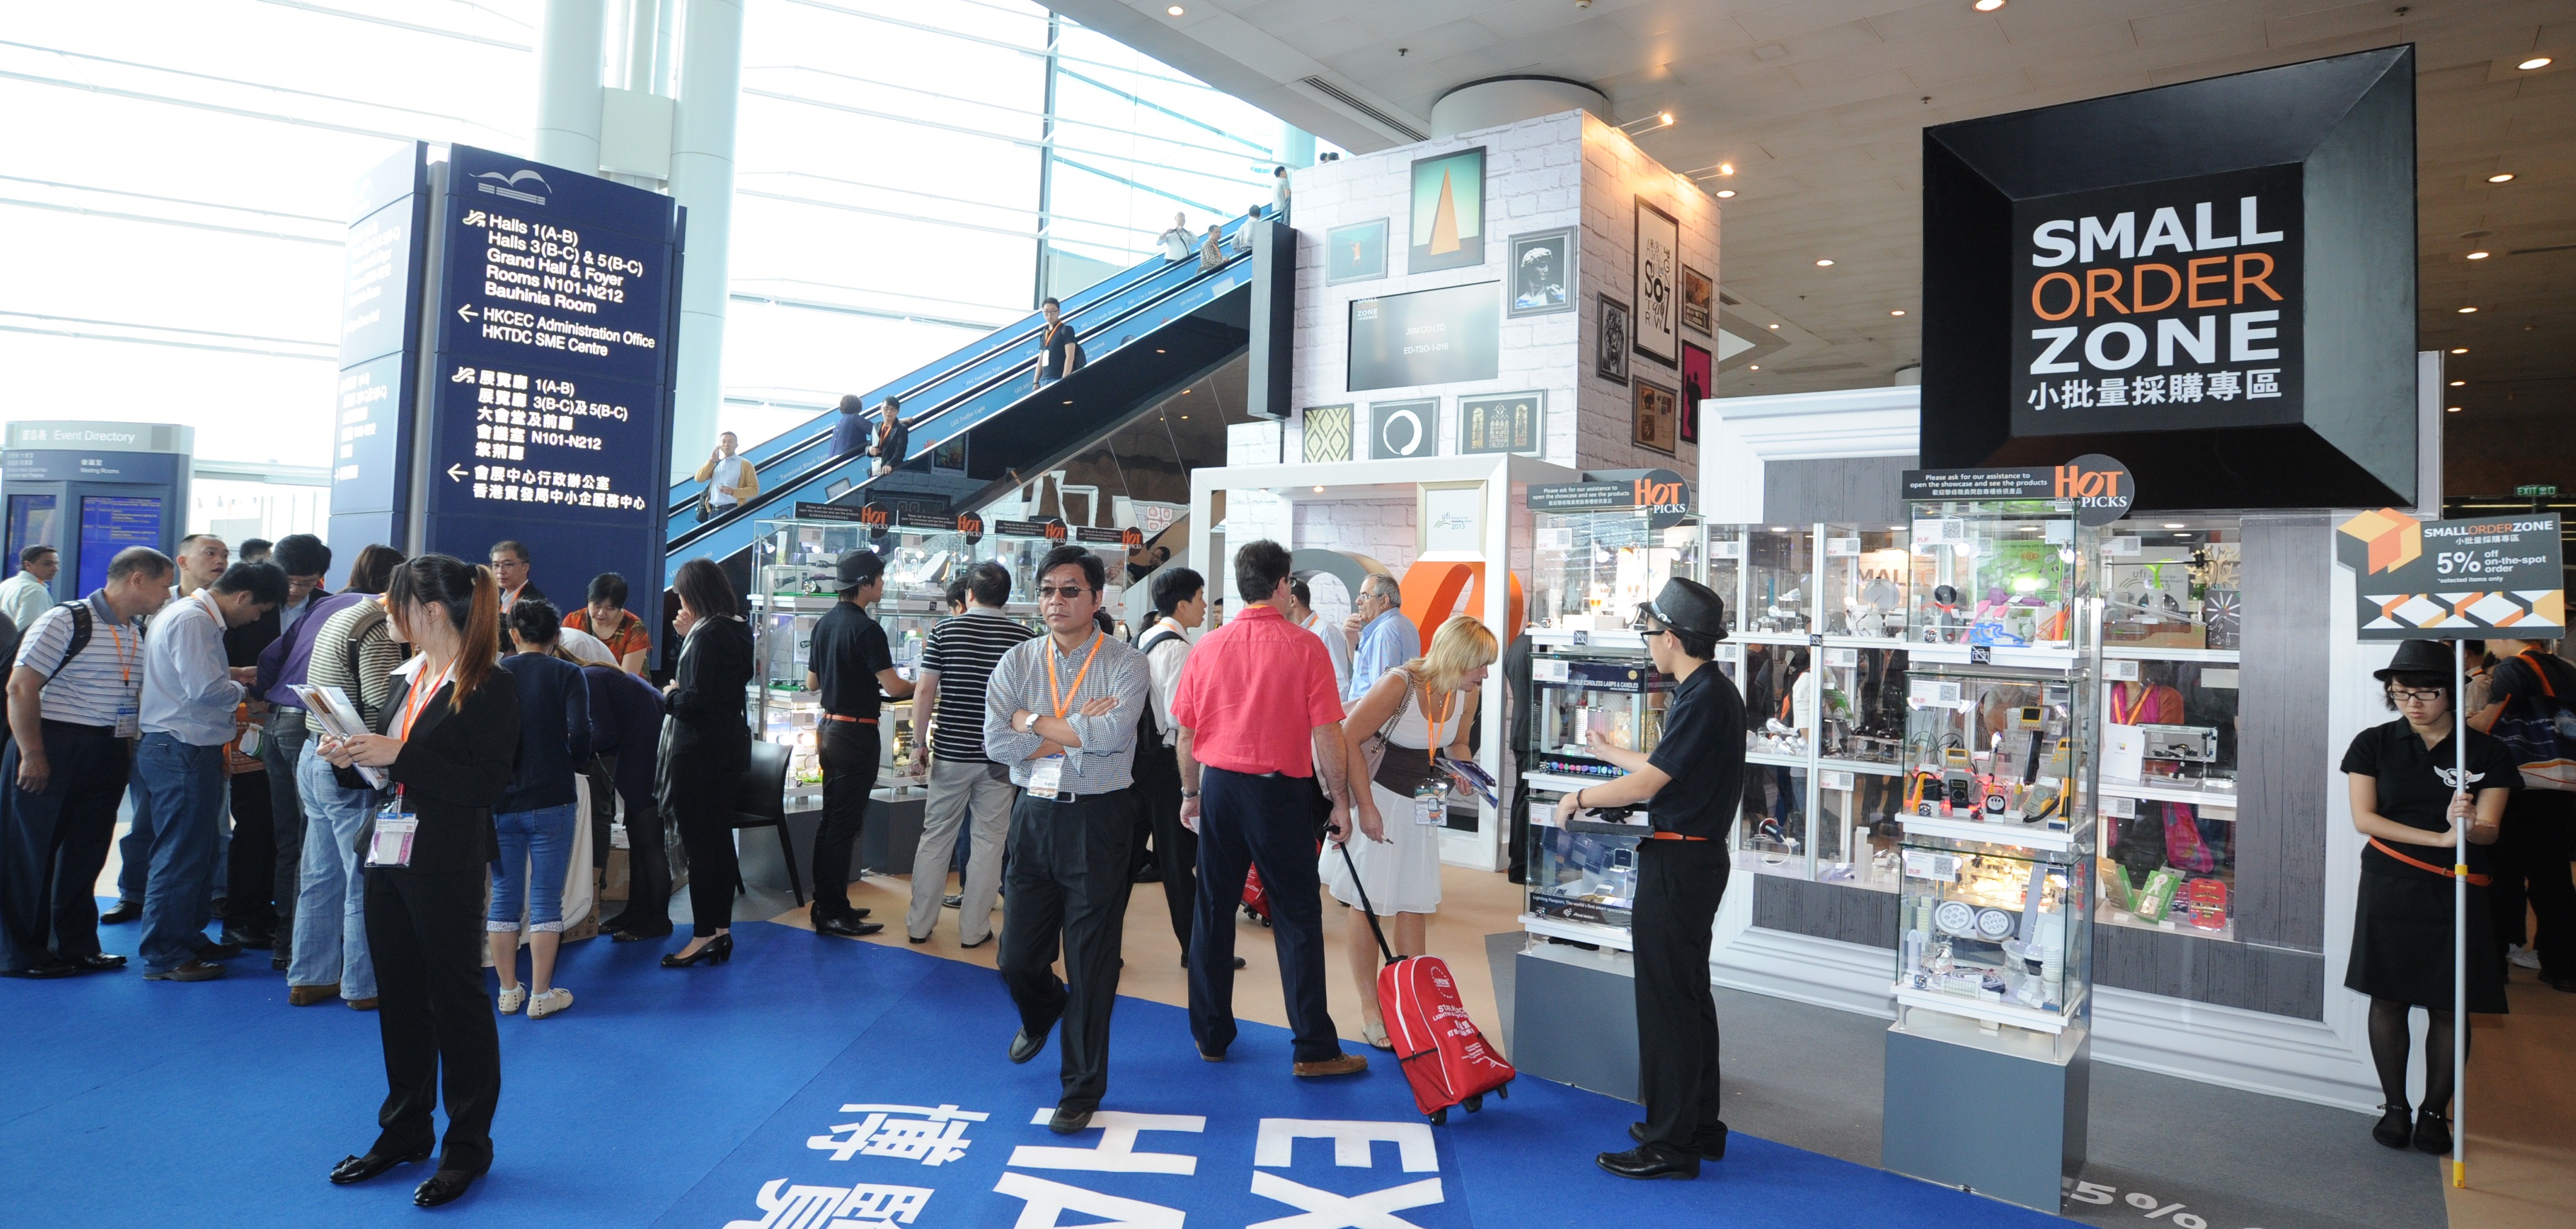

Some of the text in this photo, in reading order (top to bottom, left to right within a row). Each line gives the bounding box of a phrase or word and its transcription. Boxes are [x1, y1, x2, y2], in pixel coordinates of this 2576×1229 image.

[490, 214, 578, 247] Halls 1(A-B)
[2032, 195, 2284, 267] SMALL
[488, 231, 643, 277] Halls 3(B-C) & 5(B-C)
[487, 247, 623, 286] Grand Hall & Foyer
[486, 264, 623, 303] Rooms N101-N212
[2031, 252, 2284, 321] ORDER
[485, 281, 597, 313] Bauhinia Room
[484, 307, 656, 348] HKCEC Administration Office
[1405, 327, 1419, 335] JSM
[483, 324, 608, 356] HKTDC SME Centre
[1404, 342, 1448, 354] ED-TSO-1-016
[2030, 310, 2280, 375] ZONE
[479, 370, 574, 398] 展覽廳 1(A-B)
[966, 365, 1002, 386] PFC Function Type
[478, 388, 527, 408] 展覽廳
[1014, 385, 1023, 394] LED
[2026, 368, 2282, 411] 小批量採購專區
[477, 406, 573, 431] 大會堂及前廳
[950, 419, 959, 427] LED
[974, 405, 985, 415] Light
[53, 430, 82, 440] Event
[84, 431, 135, 444] Directory
[476, 424, 602, 450] 會議室 N101-N212
[475, 442, 524, 460] 紫荊廳
[474, 465, 610, 491] 會展中心行政辦公室
[780, 454, 829, 480] Terminal Block Type
[1635, 479, 1683, 505] HOT
[2055, 465, 2123, 497] HOT
[473, 483, 645, 510] 香港貿發局中小企服務中心
[1653, 503, 1686, 514] PICKS
[2082, 496, 2127, 508] PICKS
[862, 506, 888, 524] HOT
[958, 516, 981, 532] HOT
[1045, 523, 1066, 539] HOT
[1122, 530, 1142, 545] HOT
[2455, 534, 2520, 545] 小批量採購專區
[2437, 551, 2481, 574] 5%
[2484, 549, 2499, 558] off
[2485, 556, 2546, 566] on-the-spot
[2134, 569, 2146, 578] ufi
[2485, 565, 2513, 573] order
[2070, 1181, 2207, 1229] 5%
